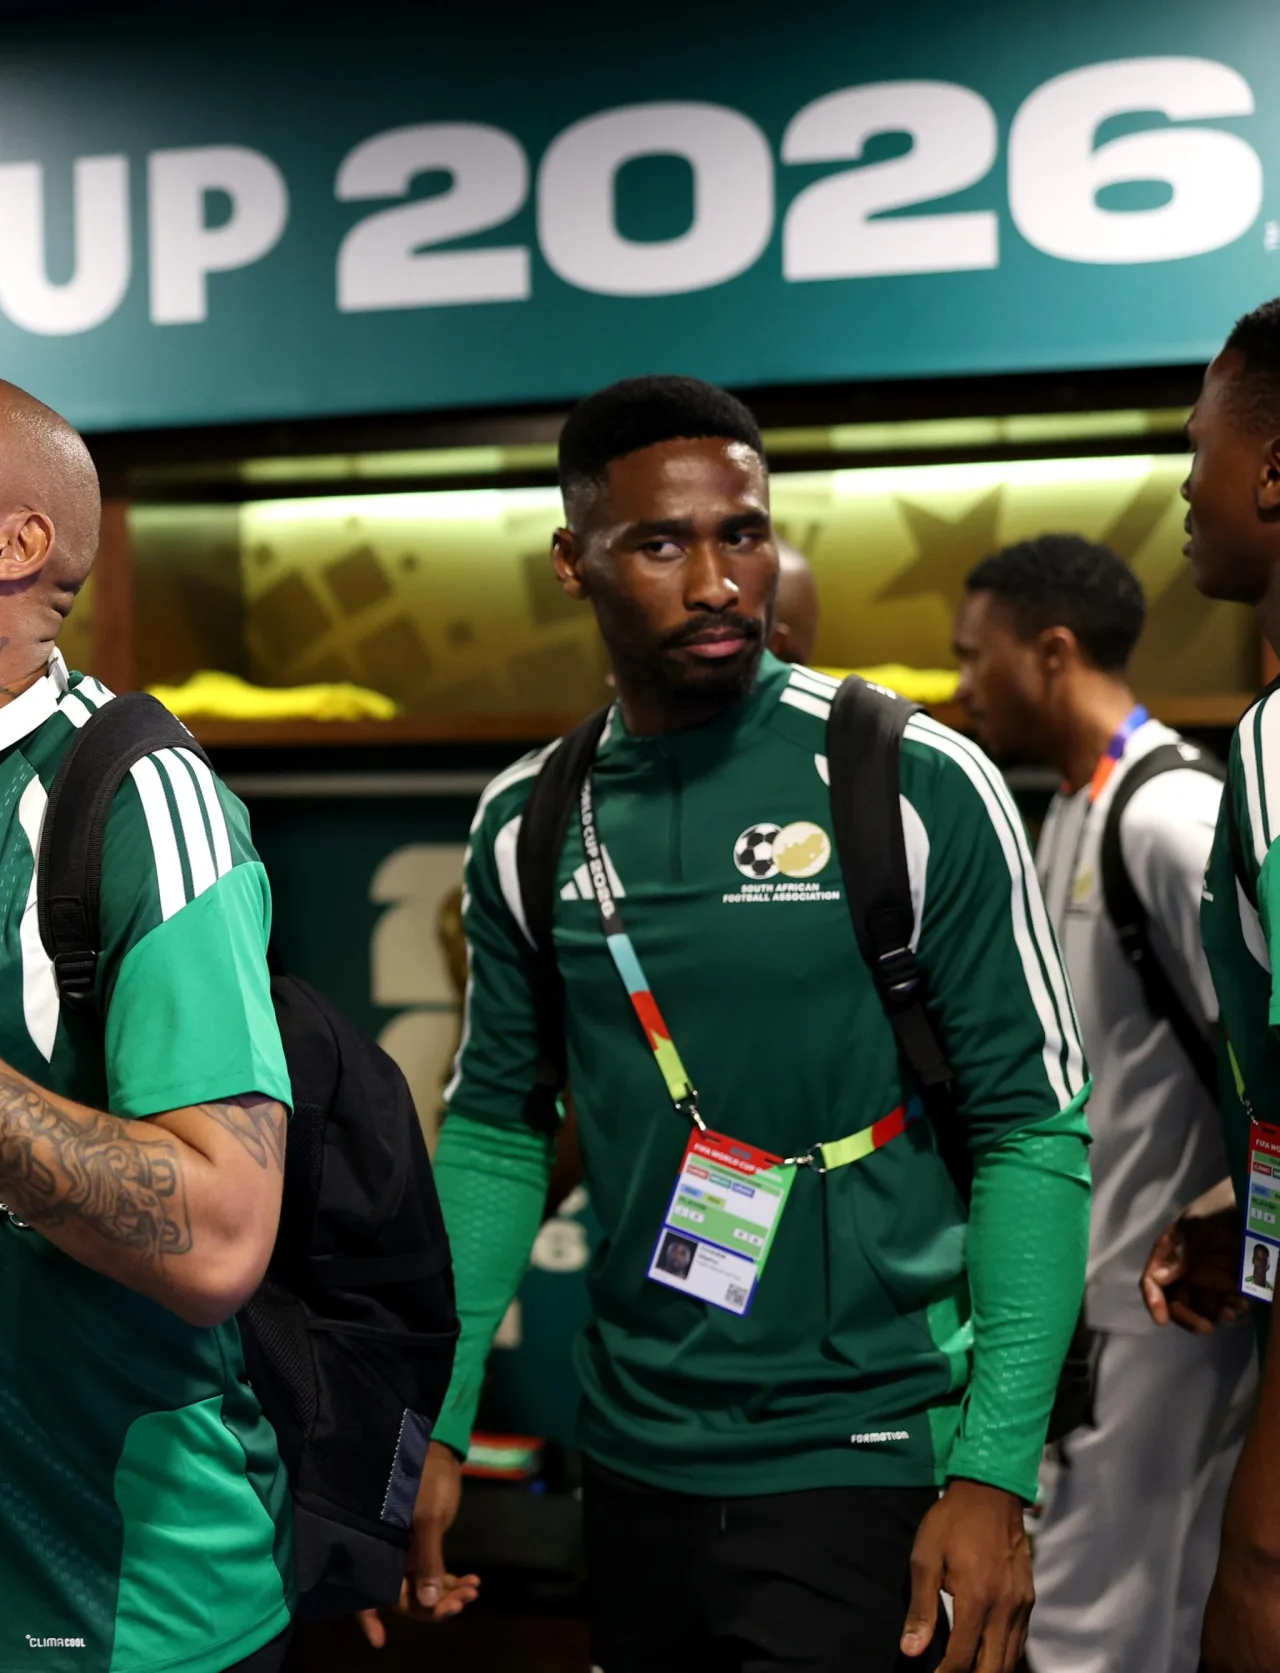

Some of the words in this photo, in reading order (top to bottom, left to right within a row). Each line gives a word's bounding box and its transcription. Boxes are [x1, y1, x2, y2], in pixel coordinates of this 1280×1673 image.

[335, 56, 1264, 311] 2026
[583, 825, 599, 858] CUP
[741, 884, 774, 893] SOUTH
[775, 883, 820, 892] AFRICAN
[722, 893, 770, 903] FOOTBALL
[772, 890, 840, 902] ASSOCIATION
[26, 1635, 86, 1647] CLIMACOOL
